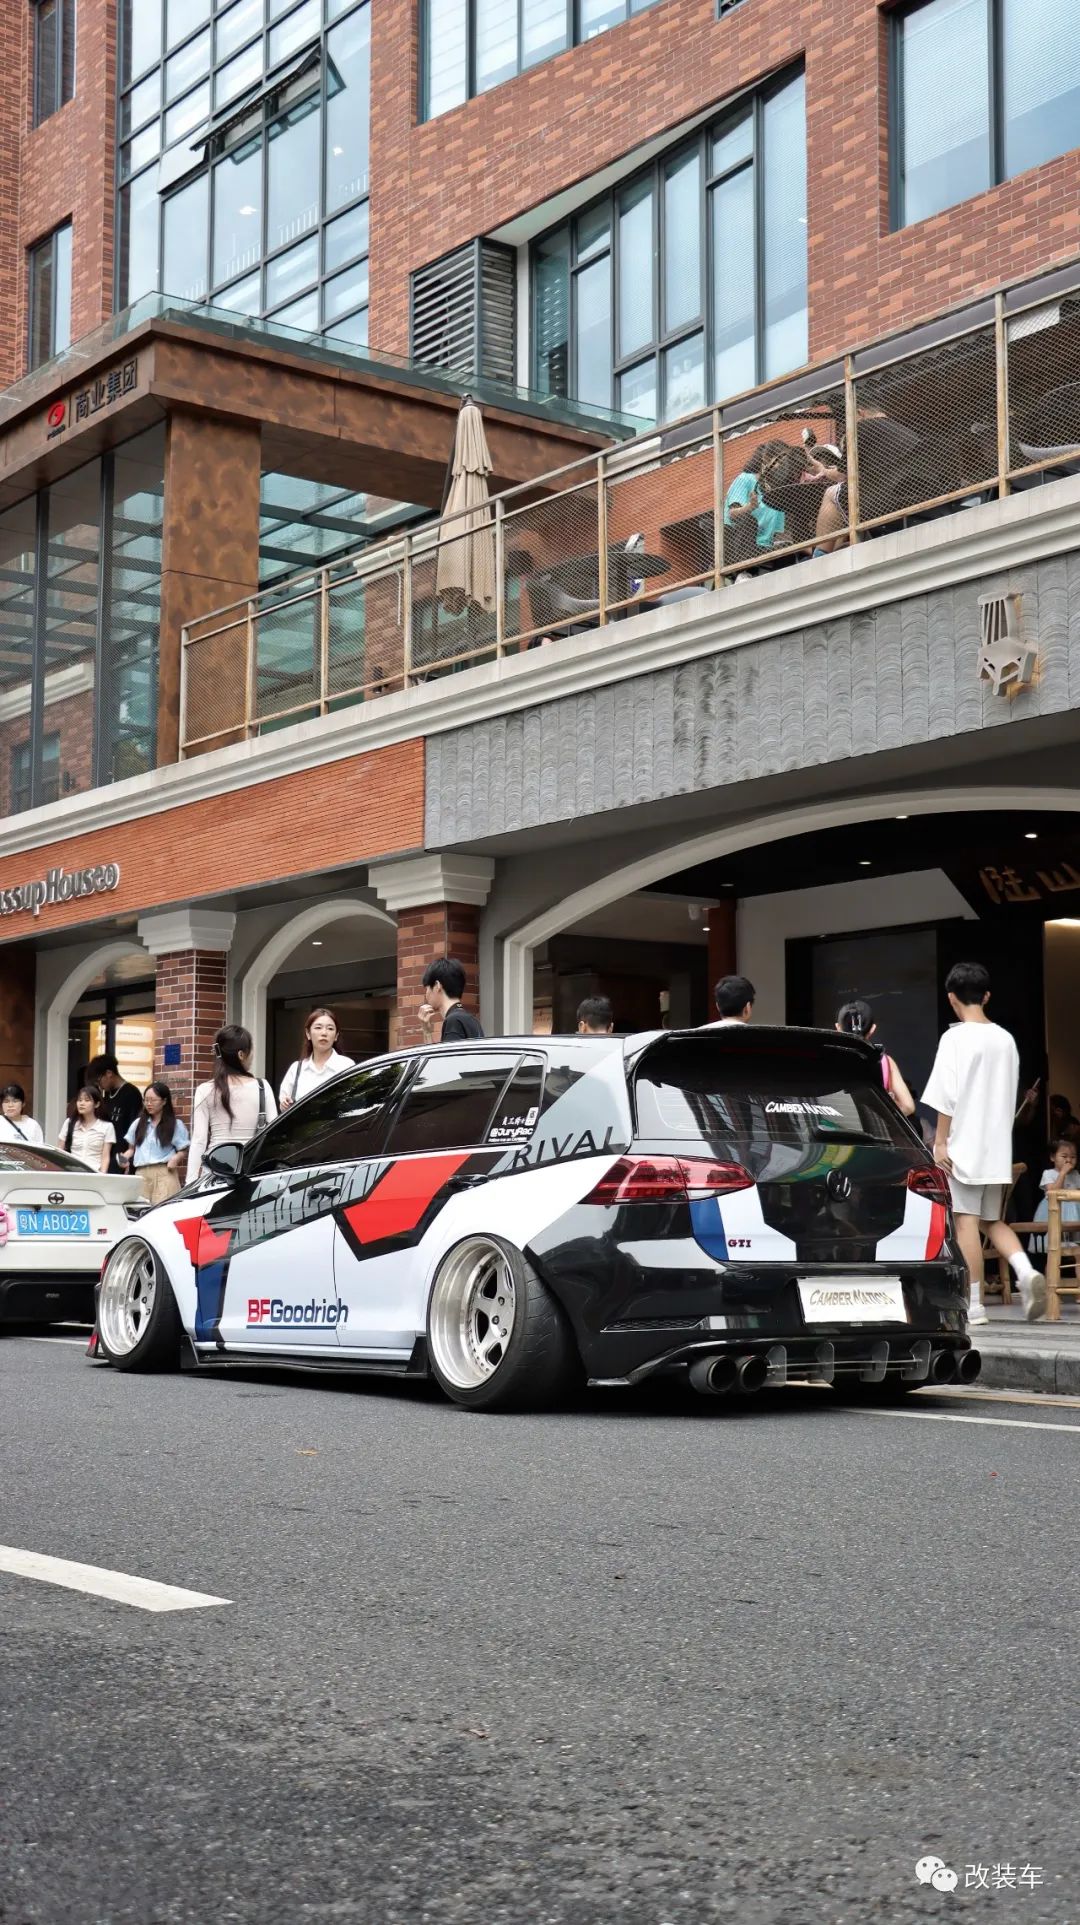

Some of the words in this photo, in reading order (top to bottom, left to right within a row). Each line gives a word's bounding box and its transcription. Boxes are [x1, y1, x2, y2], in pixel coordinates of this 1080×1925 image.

[76, 357, 138, 423] 商业集团
[765, 1101, 805, 1113] CAMBER
[512, 1126, 622, 1168] RIVAL
[728, 1239, 751, 1248] GTI
[810, 1289, 853, 1306] CAMBER
[247, 1298, 349, 1323] BFGoodrich
